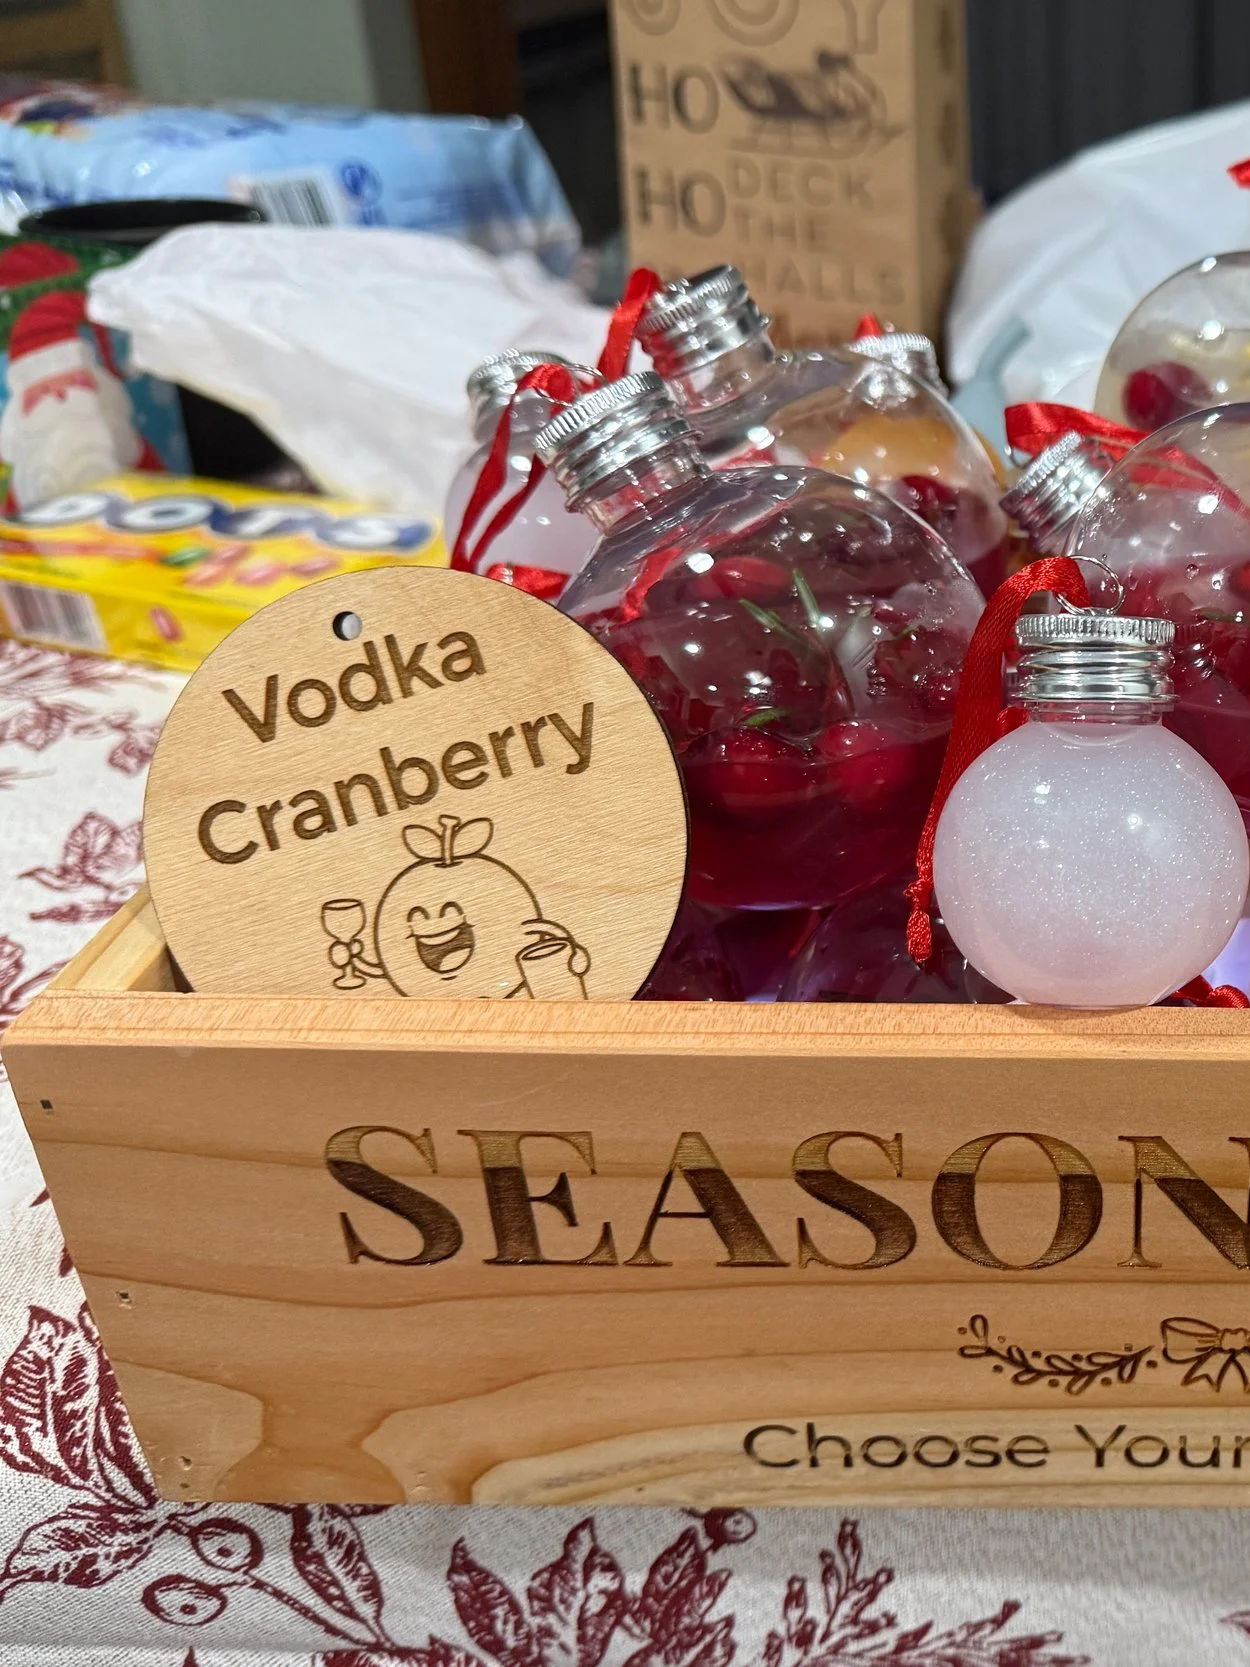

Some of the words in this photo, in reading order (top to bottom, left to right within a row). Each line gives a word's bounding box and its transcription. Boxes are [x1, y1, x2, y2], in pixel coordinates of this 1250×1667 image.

[628, 59, 721, 134] HO
[637, 167, 727, 238] HO
[223, 631, 486, 743] Vodka
[198, 702, 594, 864] Cranberry
[743, 1422, 1050, 1468] Choose
